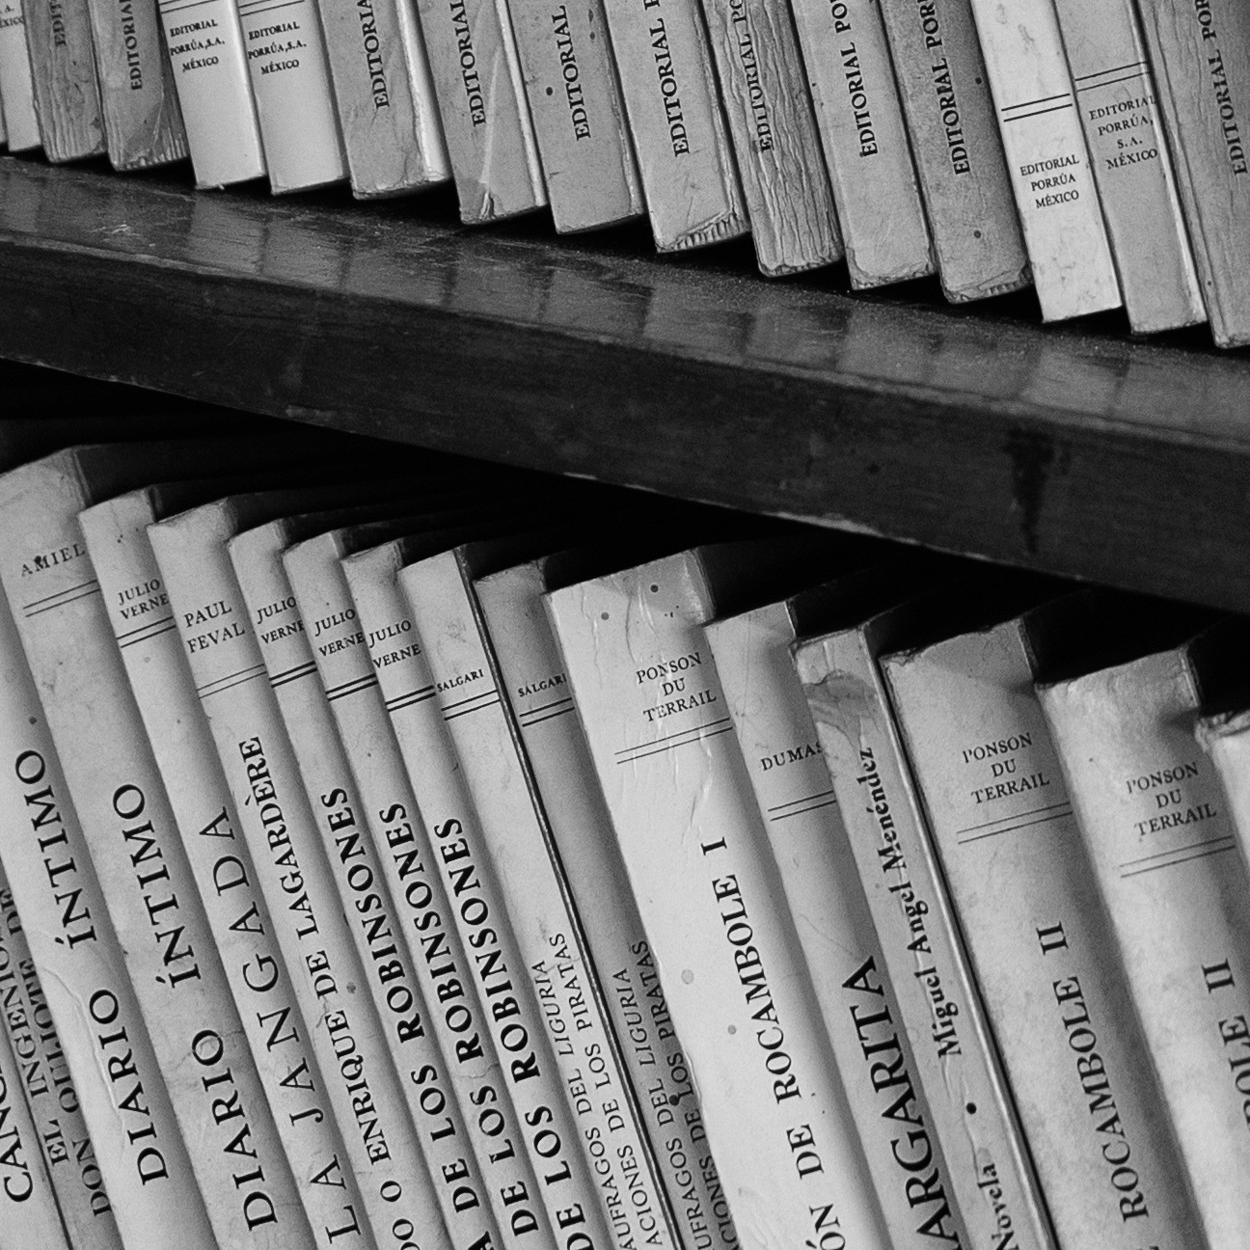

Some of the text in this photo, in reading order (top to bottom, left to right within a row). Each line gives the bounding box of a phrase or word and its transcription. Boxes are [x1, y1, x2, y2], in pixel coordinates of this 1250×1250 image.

[170, 19, 218, 38] EDITORIAL
[182, 55, 219, 73] MÉXICO
[1019, 154, 1081, 177] EDITORIAL
[1035, 188, 1081, 210] MÉXICO
[21, 544, 86, 577] AMIEL
[118, 579, 161, 605] JULIO
[120, 595, 170, 620] VERNE
[184, 599, 232, 627] PAUL
[314, 608, 356, 636] JULIO
[369, 620, 412, 647] JULIO
[188, 623, 245, 653] FEVAL
[319, 633, 364, 658] VERNE
[373, 642, 422, 669] VERNE
[436, 669, 485, 693] SALGARI
[662, 676, 686, 697] DU
[644, 692, 717, 723] TERRAIL
[991, 758, 1017, 778] DU
[972, 771, 1050, 804] TERRAIL
[1156, 789, 1182, 809] DU
[1135, 803, 1217, 837] TERRAIL
[14, 750, 169, 1184] DIARIO ÍNTIMO
[238, 736, 403, 1203] O ENRIQUE DE LAGARDÈRE
[112, 784, 277, 1231] DIARIO ÍNTIMO
[322, 789, 481, 1213] DE LOS ROBINSONES
[701, 836, 826, 1180] DE ROCAMBOLE I
[379, 803, 540, 1237] DE LOS ROBINSONES
[1035, 922, 1150, 1222] ROCAMBOLE II
[311, 1154, 362, 1245] LA
